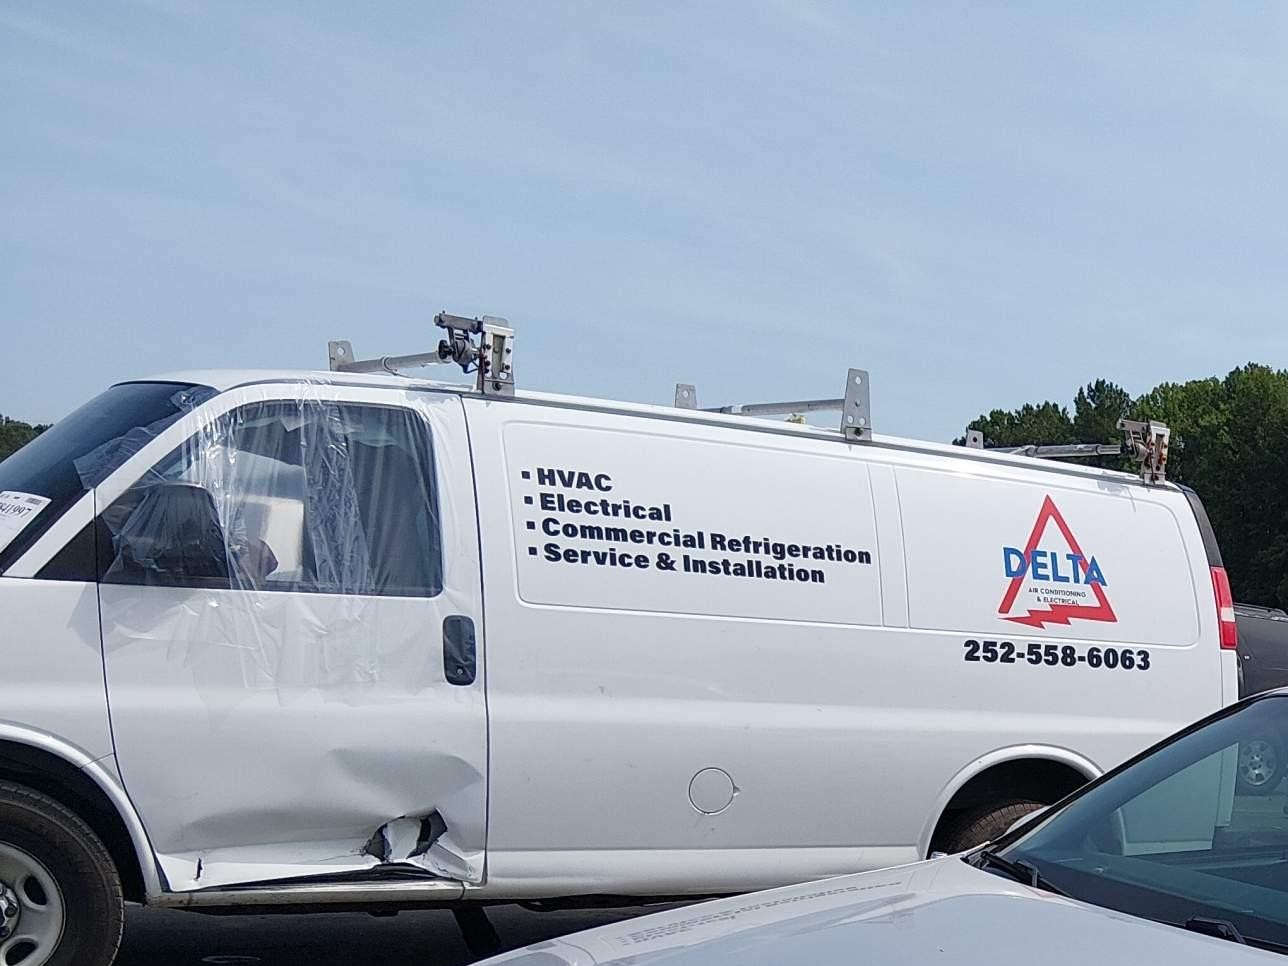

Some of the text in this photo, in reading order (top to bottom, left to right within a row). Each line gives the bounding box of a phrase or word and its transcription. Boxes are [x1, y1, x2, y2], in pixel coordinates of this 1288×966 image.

[537, 468, 612, 491] HVAC
[540, 493, 672, 521] Electrical
[542, 517, 872, 565] Commercial Refrigeration
[543, 543, 825, 583] Service & Installation
[1003, 546, 1108, 587] DELTA
[1040, 588, 1087, 598] CONDITIONING
[1043, 596, 1080, 606] ELECTRICAL
[964, 640, 1151, 671] 252-558-6063
